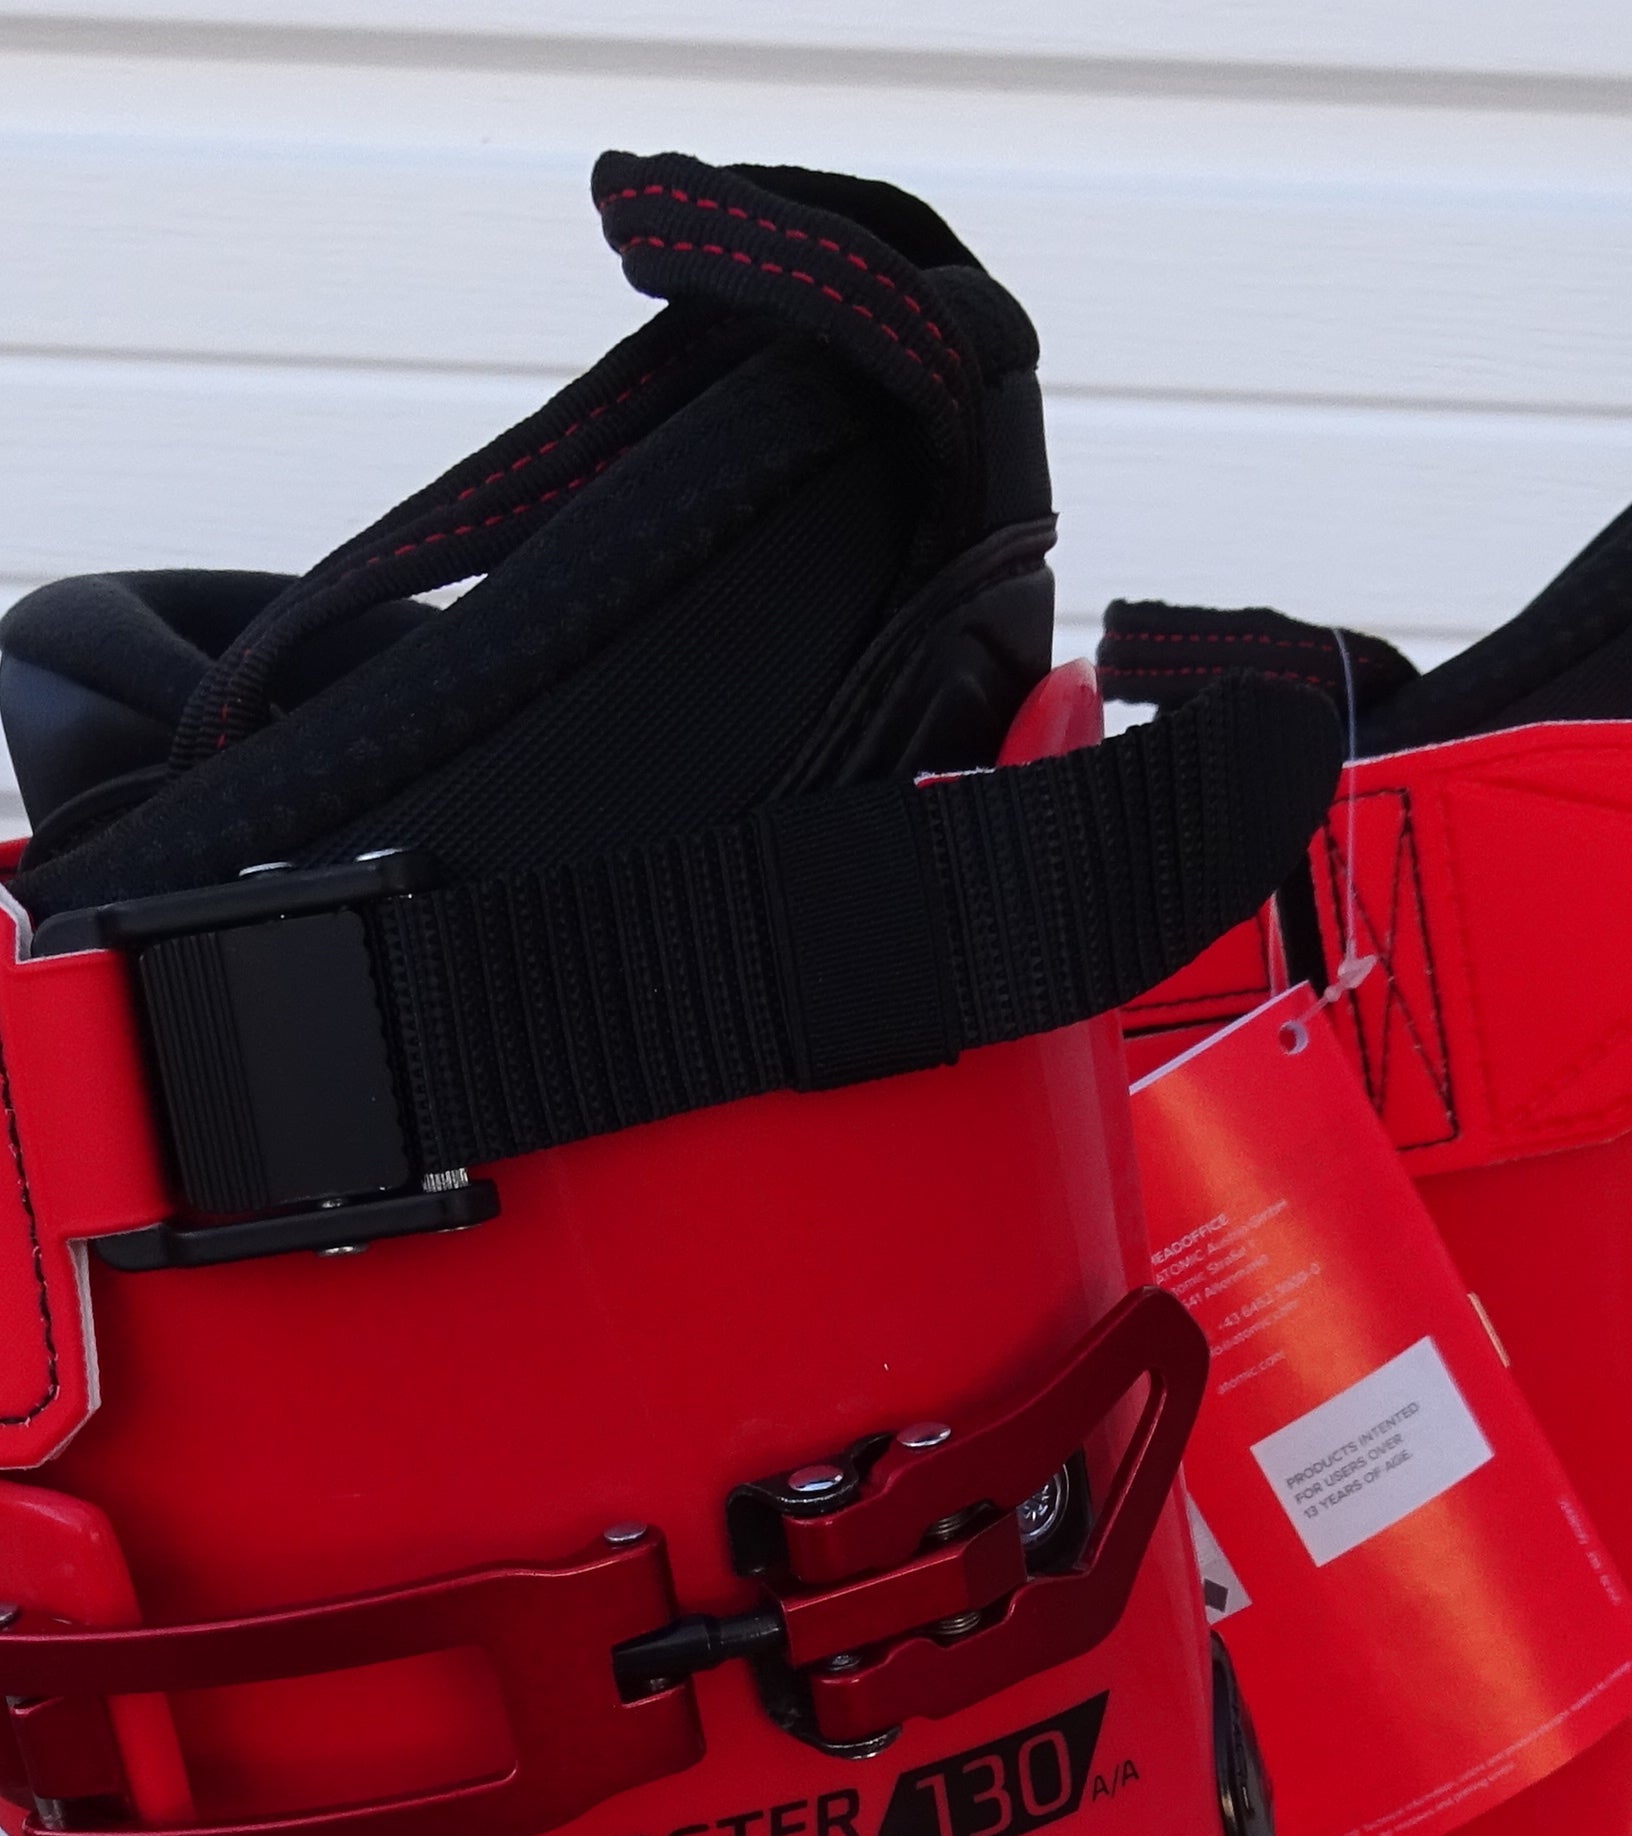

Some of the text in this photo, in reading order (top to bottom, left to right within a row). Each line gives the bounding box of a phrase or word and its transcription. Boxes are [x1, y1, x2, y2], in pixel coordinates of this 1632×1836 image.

[1286, 1401, 1420, 1490] PRODUCTS INTENTED
[1294, 1433, 1404, 1505] FOR USERS OVER
[1303, 1505, 1319, 1520] 13
[1319, 1479, 1364, 1510] YEARS
[1363, 1466, 1382, 1484] OF
[1091, 1759, 1141, 1803] A/A
